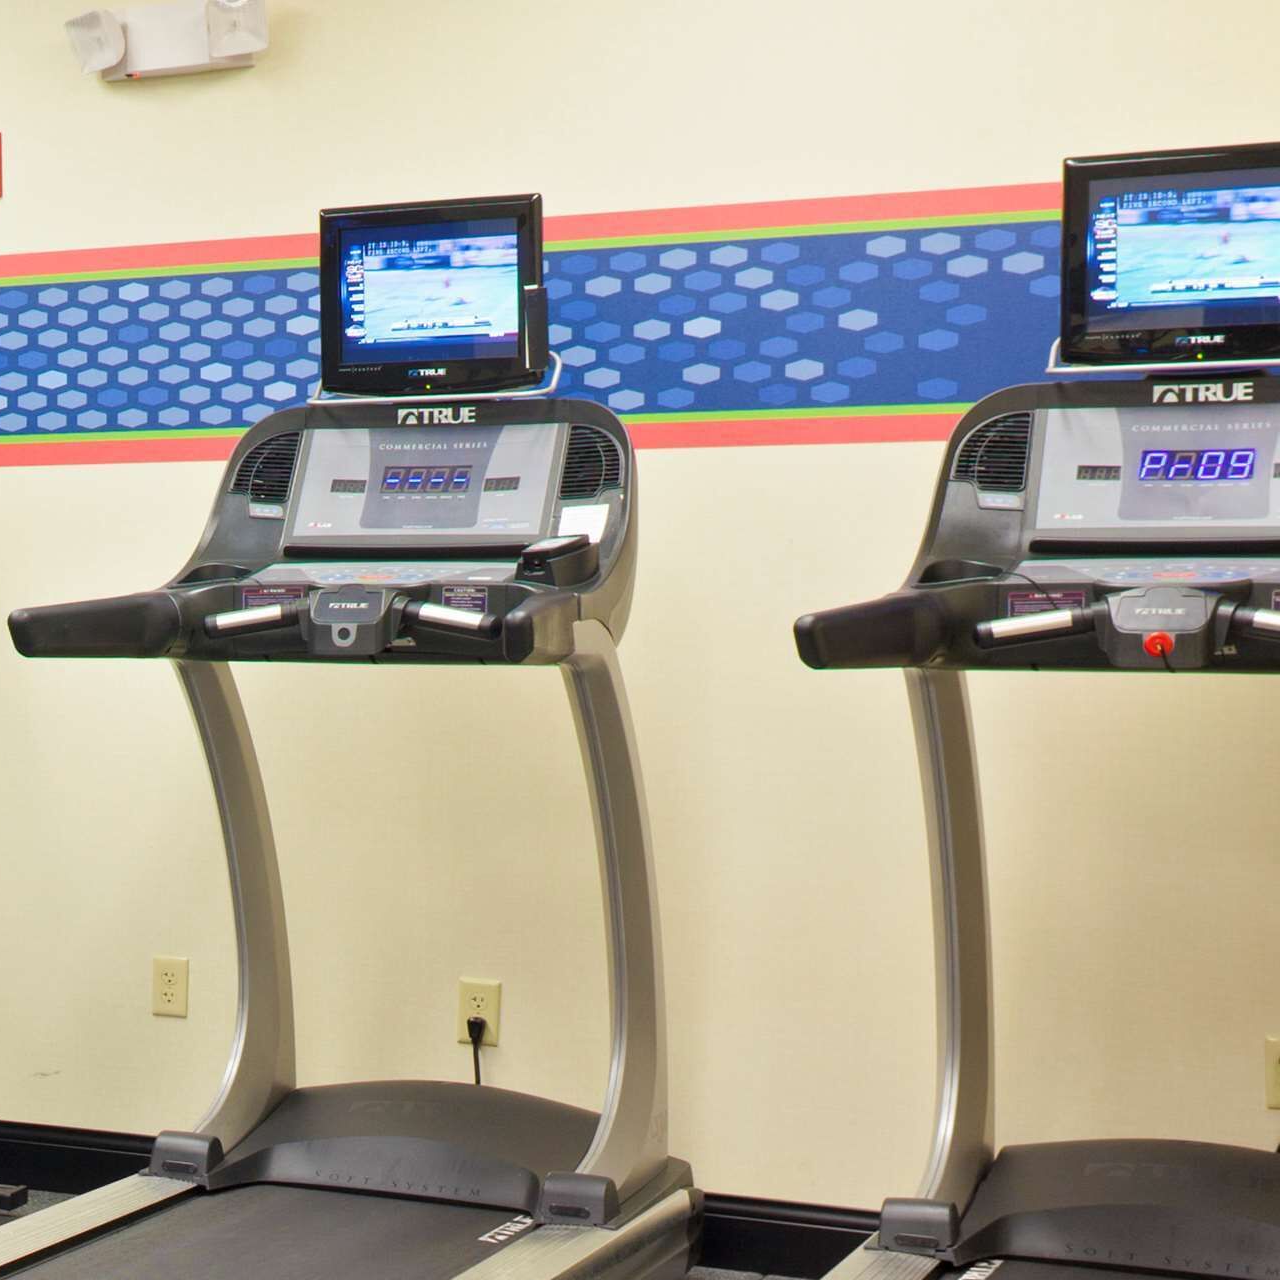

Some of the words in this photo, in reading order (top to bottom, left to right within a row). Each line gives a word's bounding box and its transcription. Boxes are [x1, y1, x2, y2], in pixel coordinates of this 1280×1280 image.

[1189, 335, 1226, 345] TRUE
[418, 368, 447, 377] TRUE
[1183, 381, 1255, 402] TRUE
[420, 407, 477, 424] TRUE
[1151, 607, 1187, 615] TRUE
[391, 1180, 482, 1198] SYSTEM
